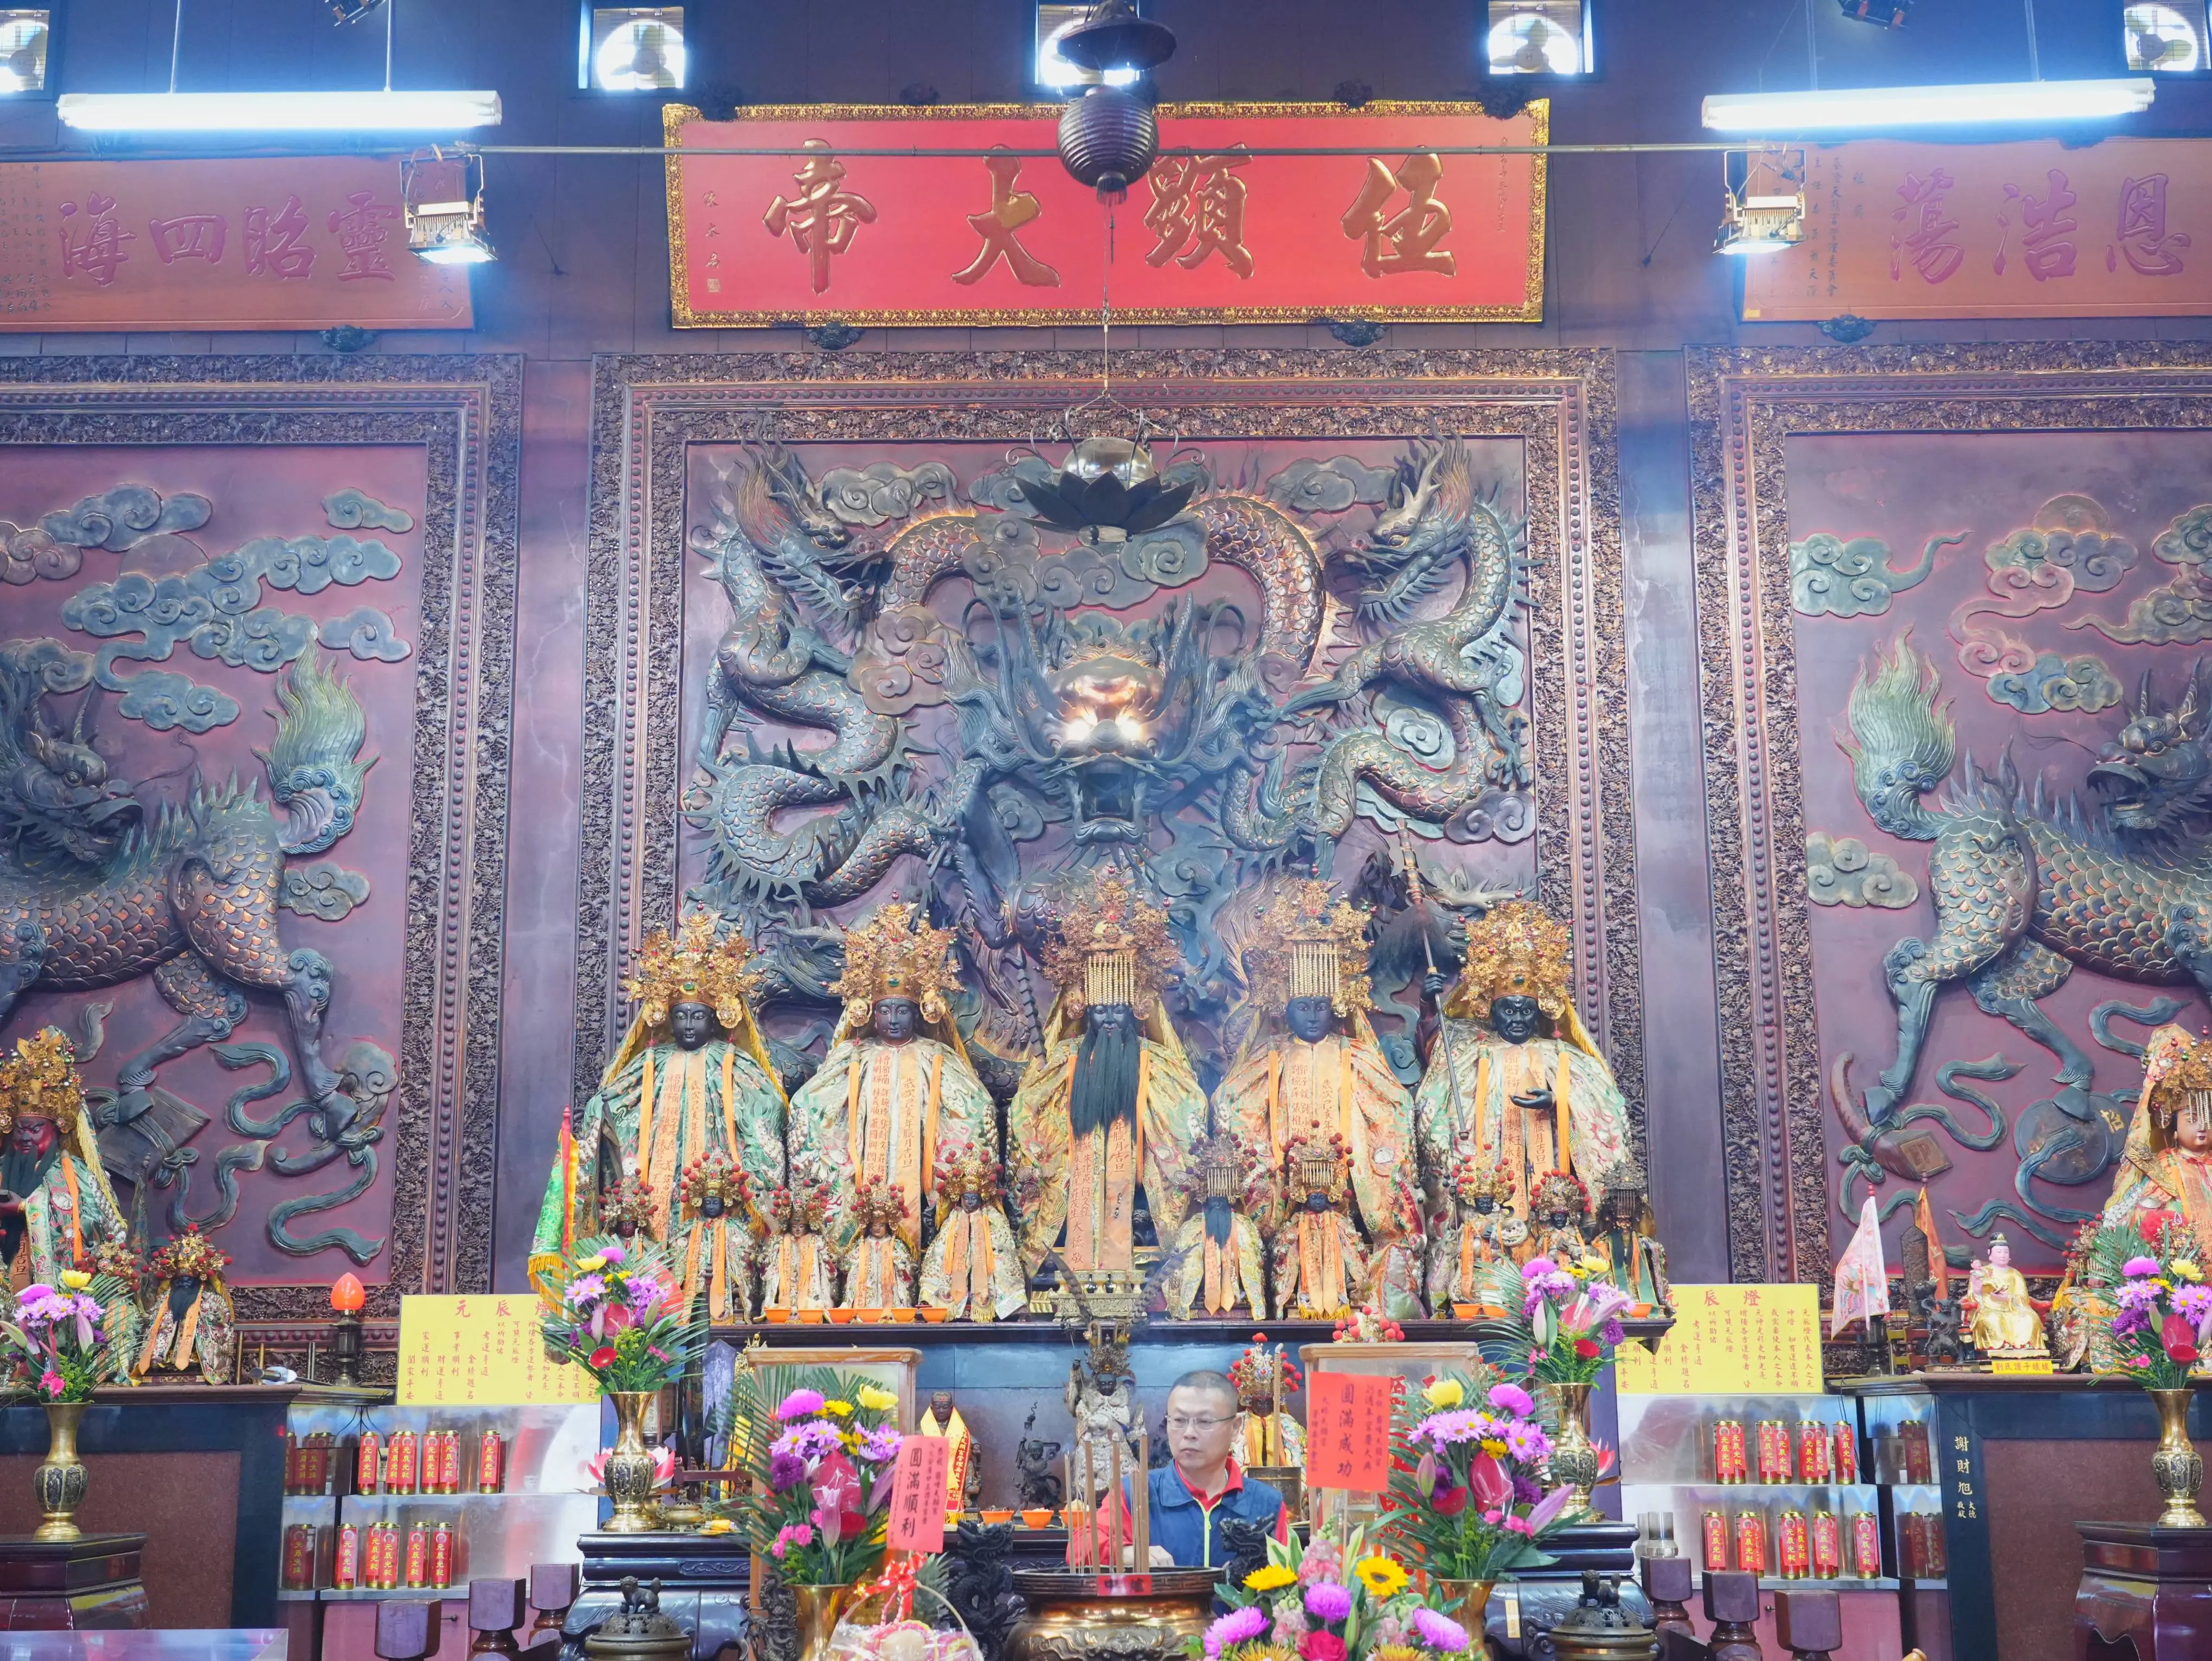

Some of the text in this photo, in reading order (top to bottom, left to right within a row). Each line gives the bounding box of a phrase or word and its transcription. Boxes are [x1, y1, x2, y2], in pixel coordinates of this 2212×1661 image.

[903, 1077, 916, 1168] 歲次己亥年臘月吉旦
[1071, 1222, 1084, 1270] 大德敬
[455, 1299, 550, 1318] 元辰燈
[1664, 1290, 1761, 1307] 元辰燈
[421, 1331, 429, 1377] 家運順利
[451, 1331, 461, 1377] 事業順利
[481, 1330, 490, 1376] 考運亨通
[1693, 1319, 1702, 1365] 考運亨通
[1803, 1309, 1814, 1388] 元辰燈代表本人之元
[435, 1355, 445, 1400] 財運亨通
[467, 1355, 476, 1399] 金榜題名
[1681, 1343, 1689, 1389] 金榜題名
[1338, 1384, 1354, 1477] 圓滿成功
[362, 1446, 372, 1478] 元辰光彩
[401, 1446, 411, 1479] 元辰光彩
[426, 1446, 436, 1478] 元辰光彩
[445, 1445, 454, 1477] 元辰光彩
[484, 1446, 494, 1479] 元辰光彩
[1721, 1436, 1731, 1468] 元辰光彩
[1732, 1435, 1742, 1466] 元辰光彩
[1764, 1435, 1773, 1467] 元辰光彩
[1778, 1441, 1787, 1472] 元辰光彩
[1805, 1440, 1814, 1472] 元辰光彩
[1842, 1433, 1851, 1465] 元辰光彩
[1954, 1436, 1972, 1495] 謝財旭
[901, 1448, 922, 1538] 圓滿順利
[342, 1541, 352, 1574] 元辰光彩
[370, 1538, 380, 1571] 元辰光彩
[384, 1543, 394, 1576] 元辰光彩
[411, 1543, 421, 1576] 元辰光彩
[436, 1543, 446, 1576] 元辰光彩
[1711, 1529, 1721, 1561] 元辰光彩
[1745, 1530, 1754, 1562] 元辰光彩
[1786, 1529, 1796, 1561] 元辰光彩
[1797, 1527, 1805, 1560] 元辰光彩
[1819, 1527, 1829, 1560] 元辰光彩
[1861, 1532, 1871, 1566] 元辰光彩
